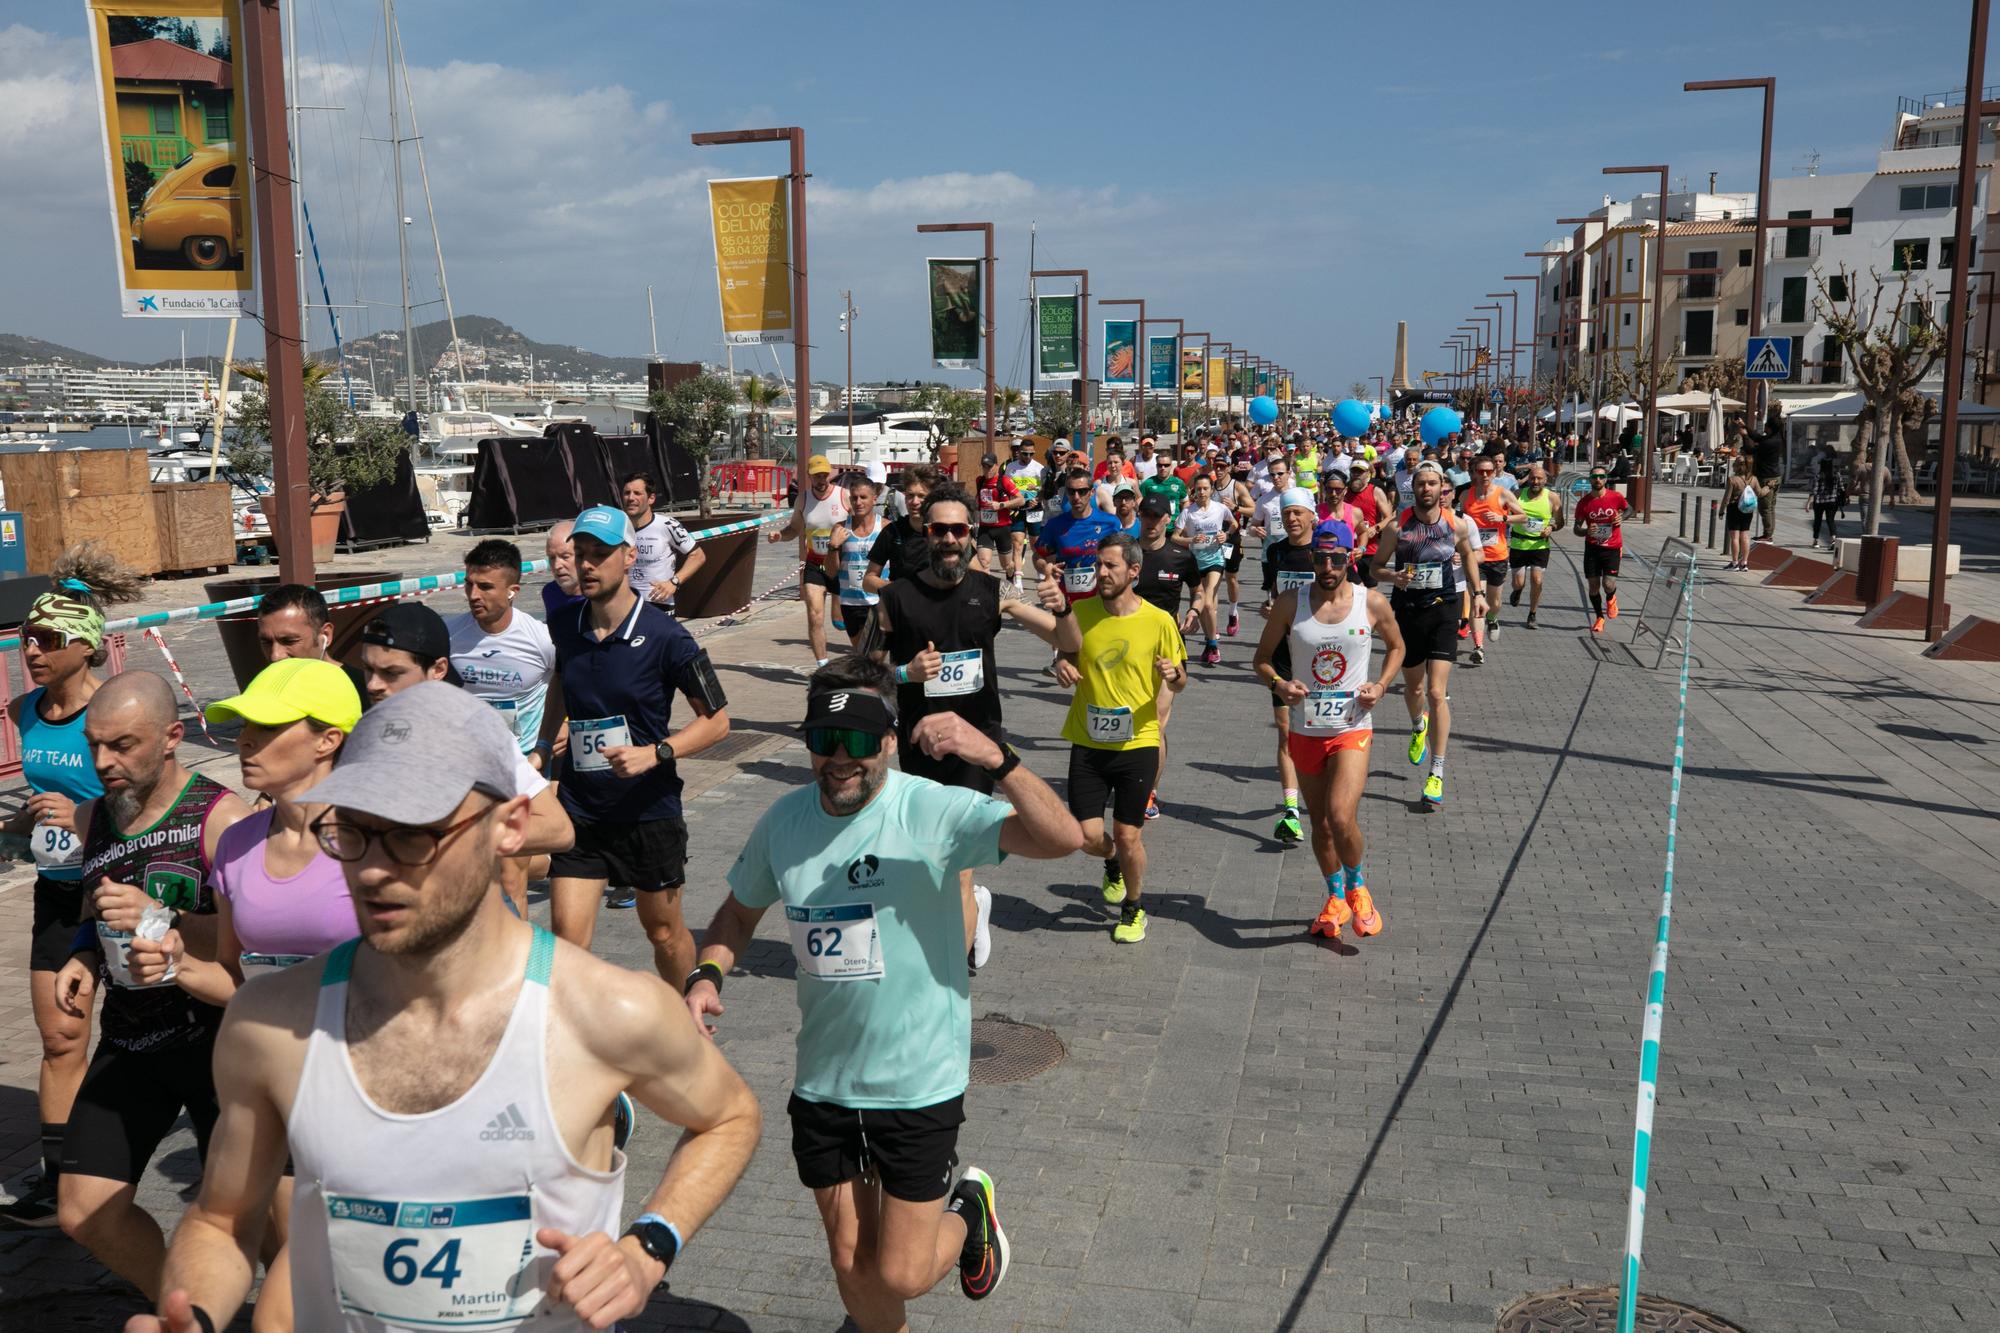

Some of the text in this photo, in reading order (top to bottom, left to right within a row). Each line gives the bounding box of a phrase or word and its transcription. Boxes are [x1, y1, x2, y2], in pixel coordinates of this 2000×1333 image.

[718, 202, 780, 218] COLORS
[720, 218, 748, 233] DEL
[162, 298, 205, 308] Fundació
[735, 333, 784, 344] CaixaForum
[1069, 574, 1089, 585] 132
[480, 670, 523, 682] IBIZA
[940, 664, 964, 683] 86
[1314, 701, 1344, 717] 125
[1092, 716, 1121, 732] 129
[582, 733, 607, 755] 56
[46, 750, 83, 768] TEAM
[45, 829, 72, 853] 98
[126, 831, 166, 854] group
[806, 927, 843, 957] 62
[844, 958, 868, 971] Otero
[480, 1126, 535, 1141] adidas
[350, 1202, 387, 1218] IBIZA
[382, 1237, 462, 1289] 64
[451, 1290, 508, 1306] Martin
